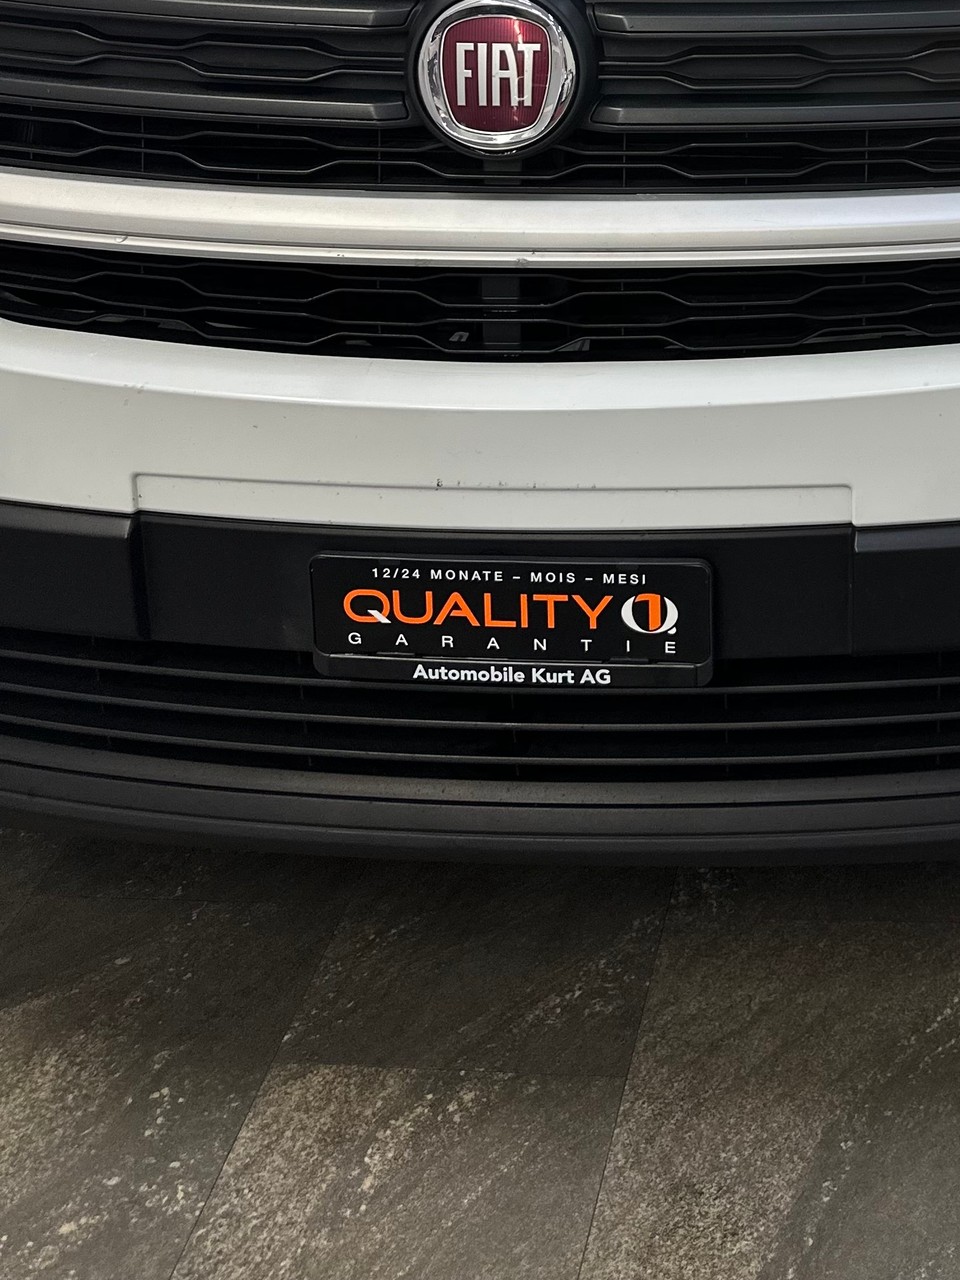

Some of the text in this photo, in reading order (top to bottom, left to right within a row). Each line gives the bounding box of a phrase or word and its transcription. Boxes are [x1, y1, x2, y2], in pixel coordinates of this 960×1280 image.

[456, 42, 541, 107] FIAT
[371, 567, 421, 579] 12/24
[430, 568, 503, 582] MONATE
[530, 571, 576, 584] MOIS
[602, 573, 646, 585] MESI
[343, 588, 613, 630] QUALITY
[413, 664, 611, 684] Automobile Kurt AG
